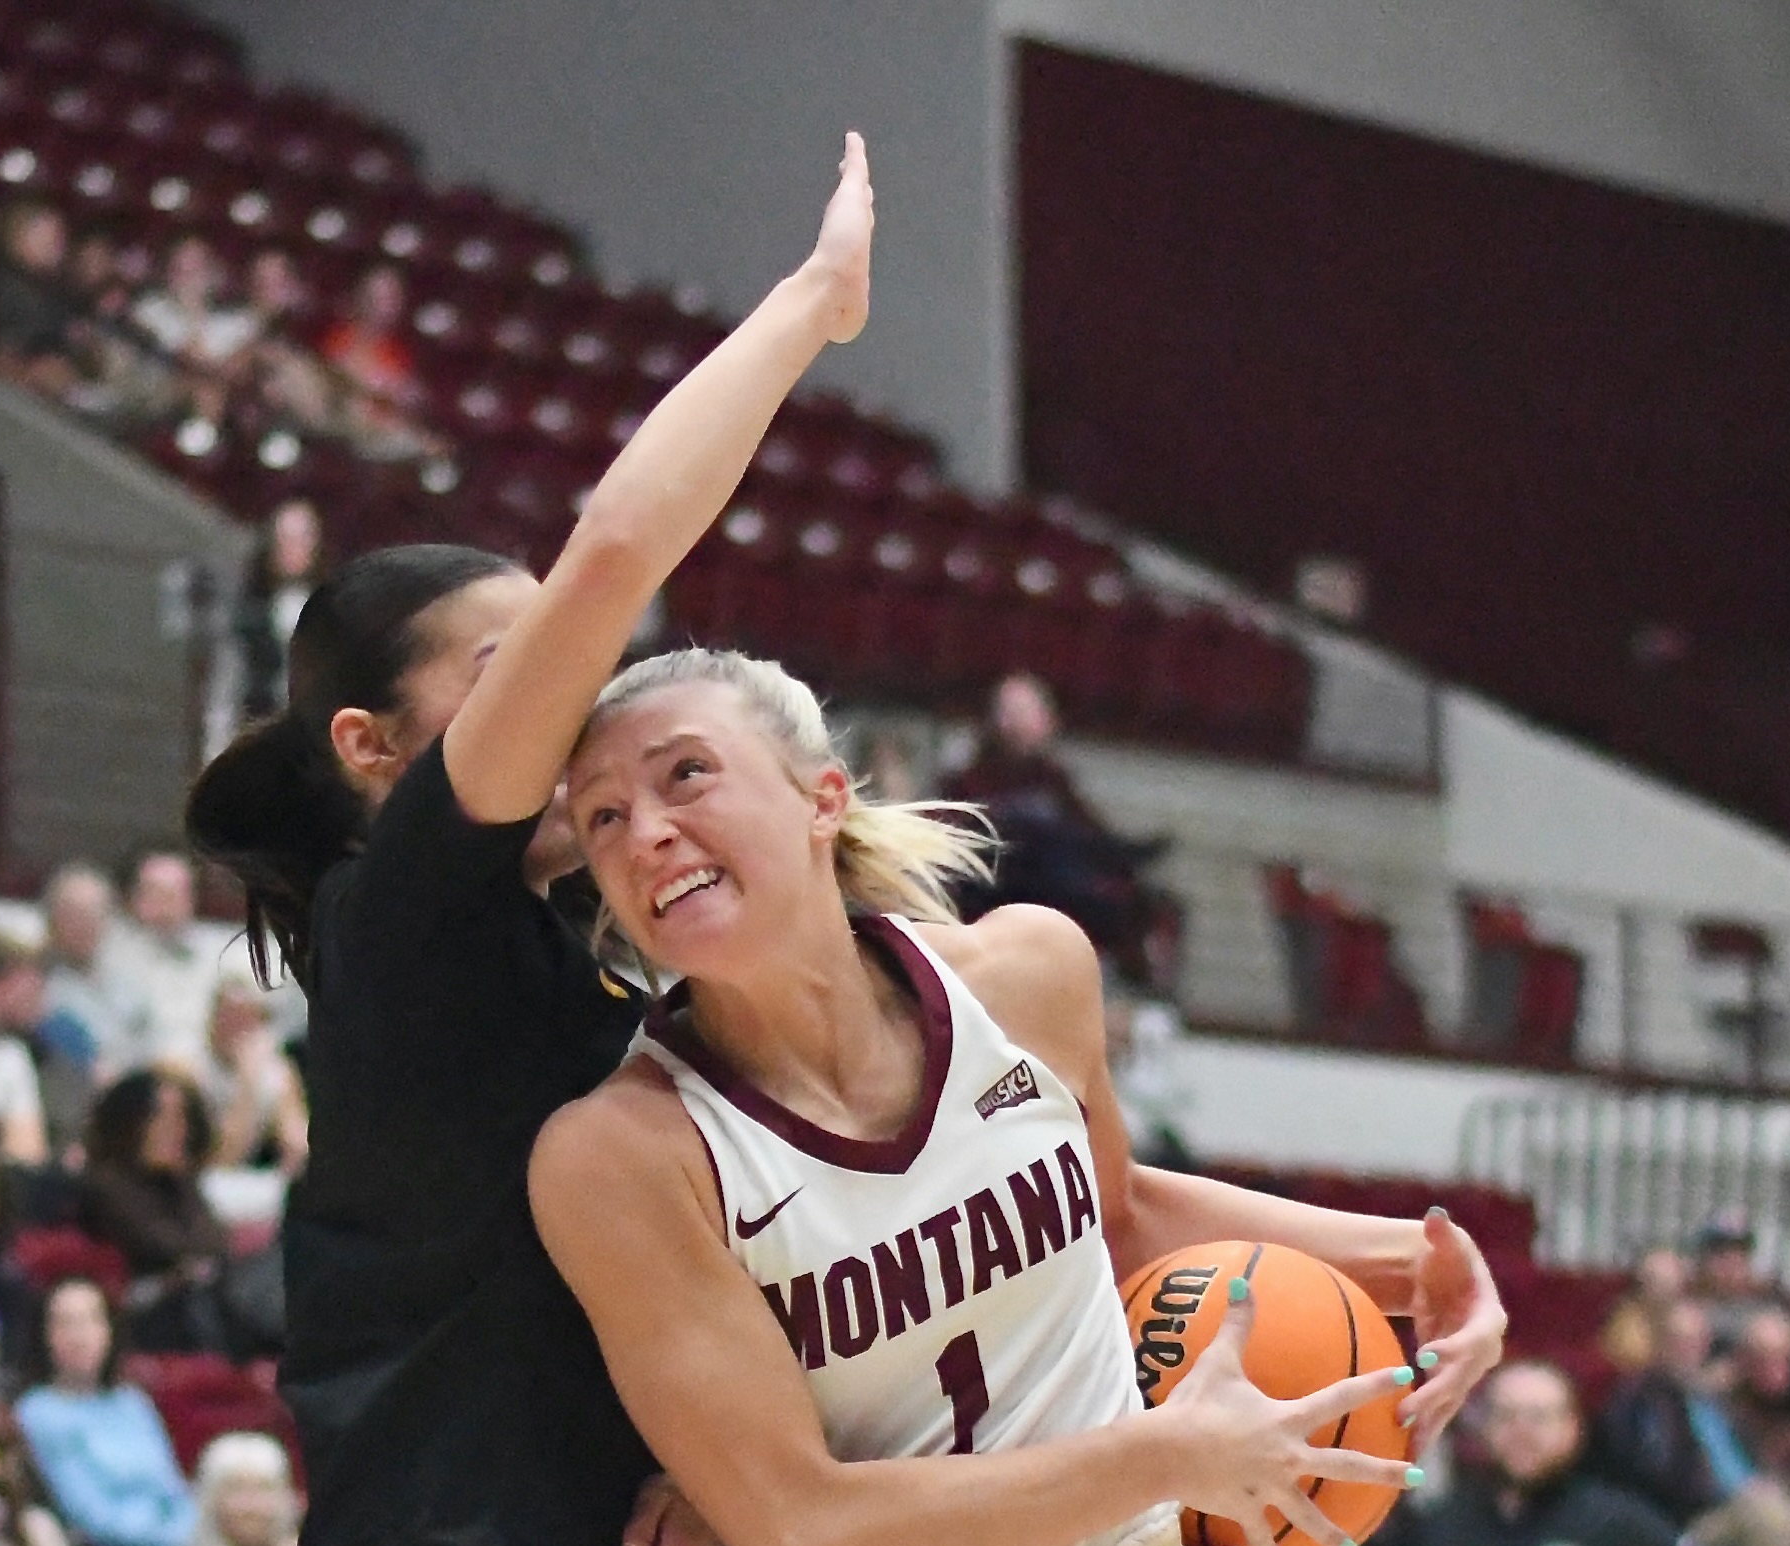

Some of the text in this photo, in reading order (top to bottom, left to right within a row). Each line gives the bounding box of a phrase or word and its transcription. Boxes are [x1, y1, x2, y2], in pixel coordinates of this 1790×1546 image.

[996, 1063, 1033, 1103] SKY
[760, 1141, 1097, 1370] MONTANA
[935, 1329, 990, 1456] 1
[1134, 1265, 1220, 1411] Wils
